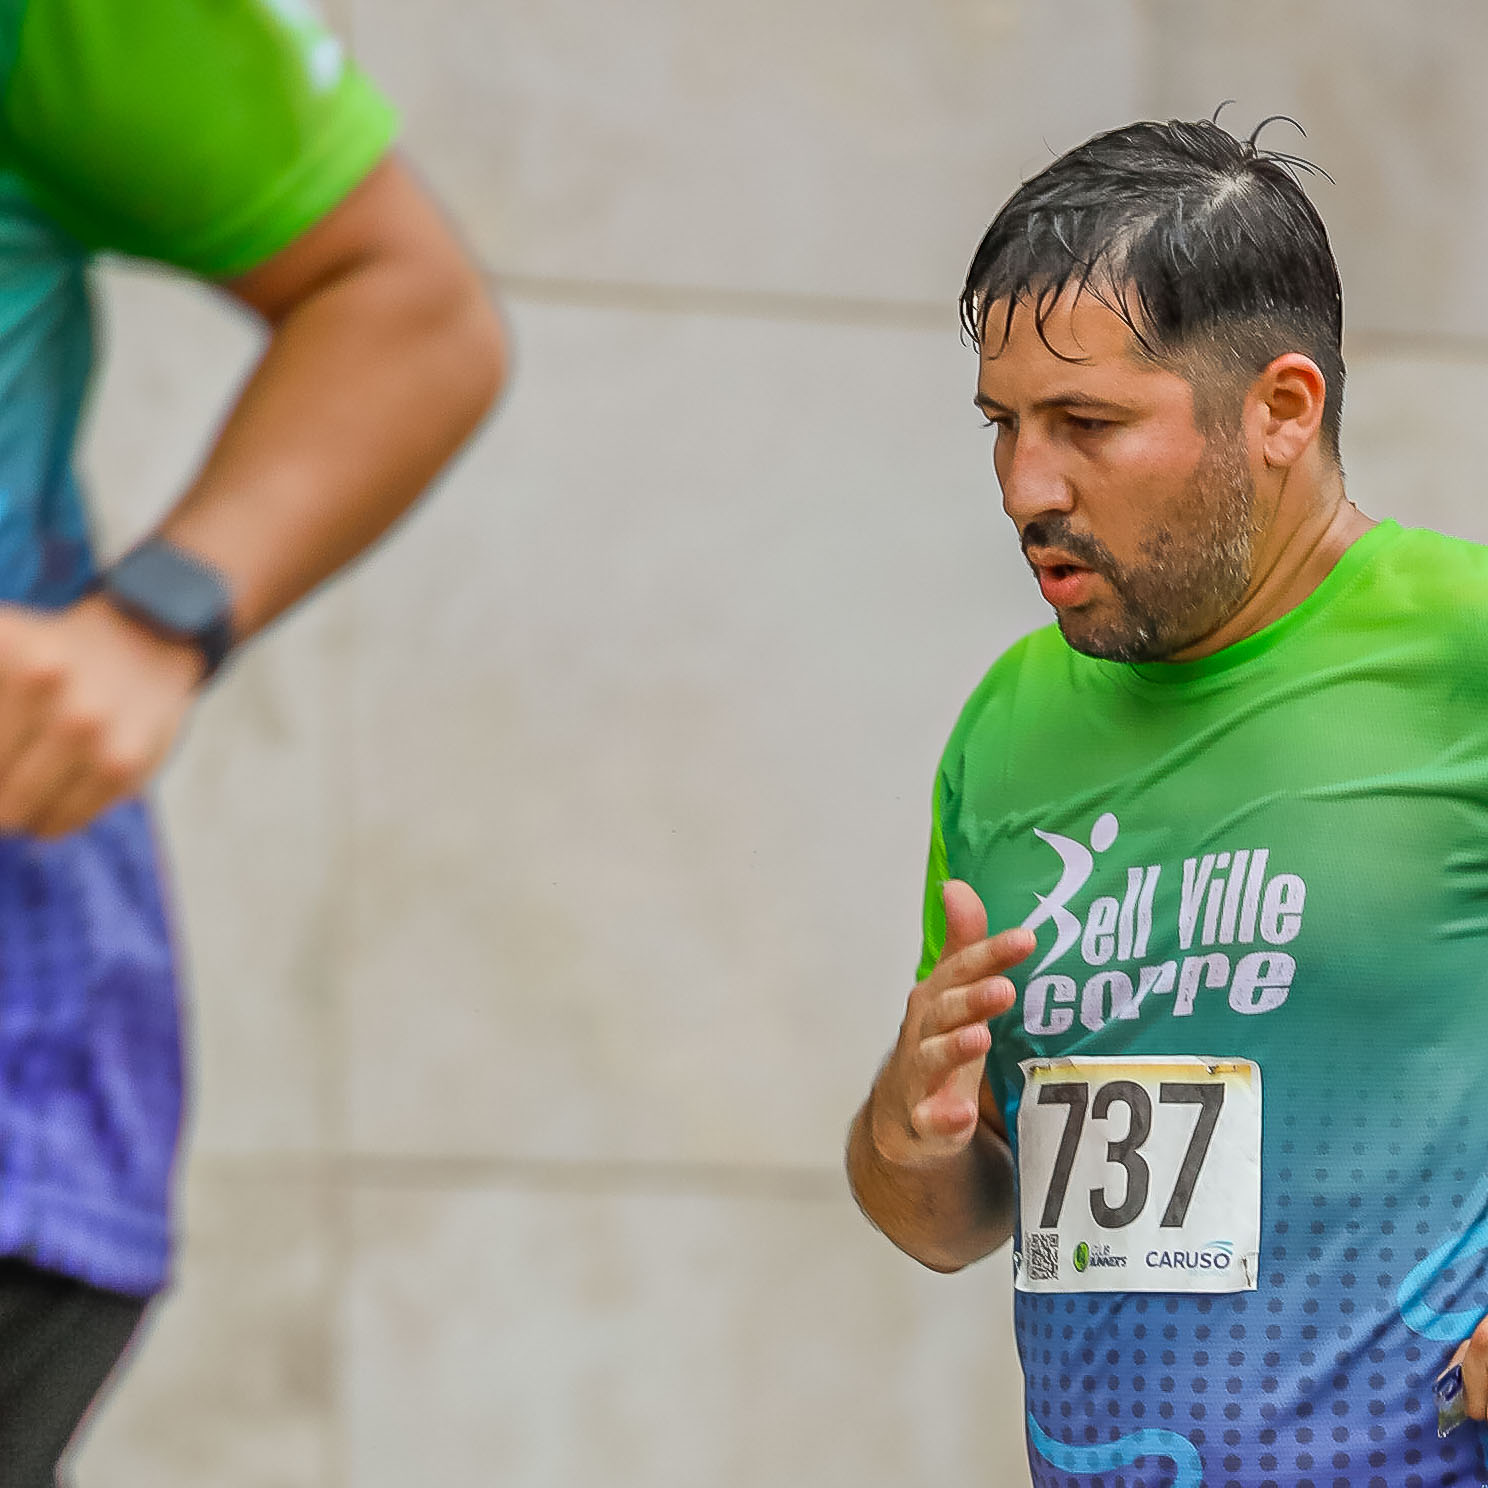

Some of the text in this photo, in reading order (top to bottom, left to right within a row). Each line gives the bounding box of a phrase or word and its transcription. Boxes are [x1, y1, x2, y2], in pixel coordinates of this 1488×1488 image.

[1178, 848, 1306, 950] Ville
[1022, 950, 1298, 1036] corre
[1036, 1081, 1226, 1230] 737
[1145, 1251, 1231, 1270] CARUSO
